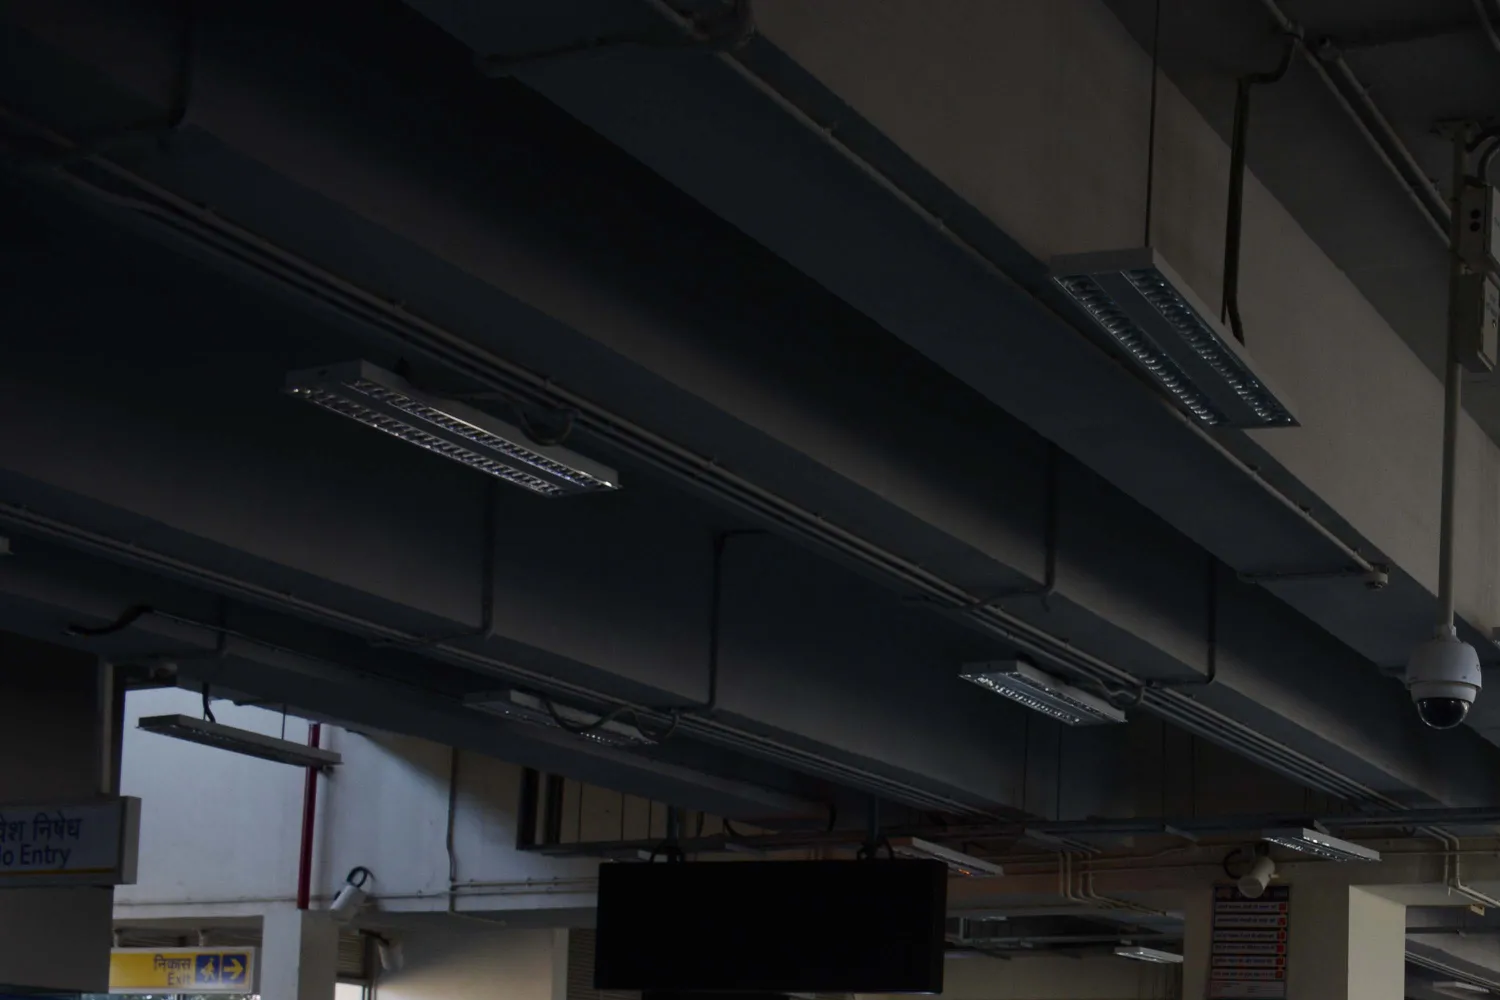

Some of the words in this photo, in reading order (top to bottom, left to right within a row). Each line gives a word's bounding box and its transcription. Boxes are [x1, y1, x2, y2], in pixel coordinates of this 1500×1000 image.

[33, 812, 82, 841] निषेध
[0, 845, 15, 866] o
[21, 844, 71, 869] Entry
[153, 954, 193, 972] निकास
[167, 972, 192, 986] Exit
